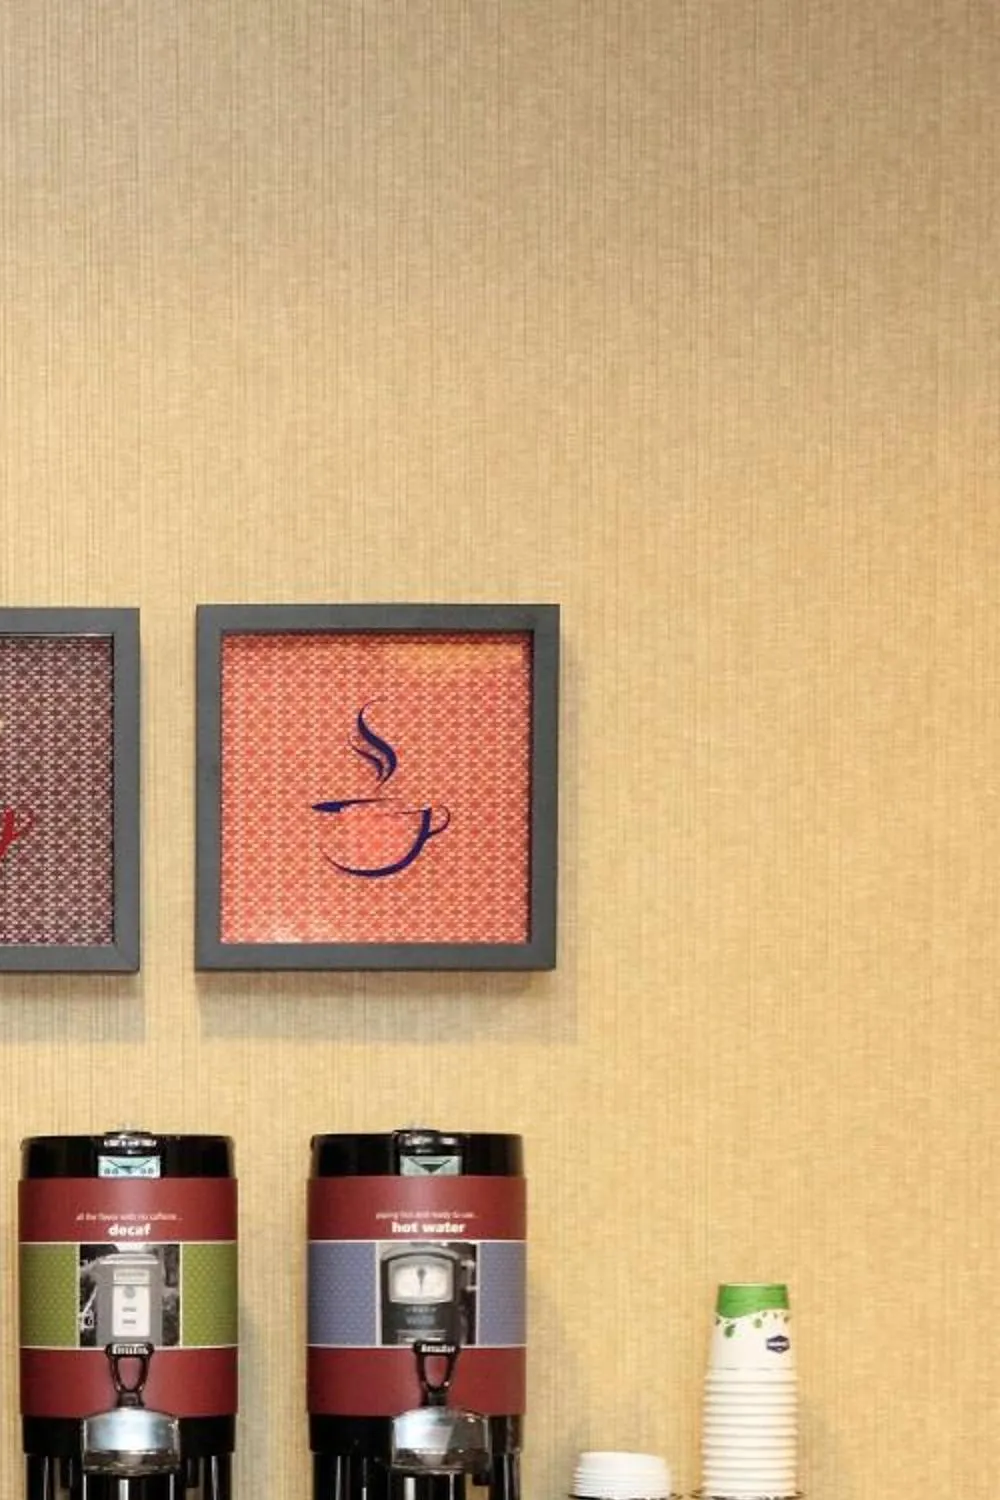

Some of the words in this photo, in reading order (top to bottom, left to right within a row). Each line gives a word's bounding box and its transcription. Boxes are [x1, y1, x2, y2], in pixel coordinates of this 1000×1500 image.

[108, 1222, 151, 1236] decaf
[391, 1221, 418, 1233] hot
[422, 1221, 467, 1233] water
